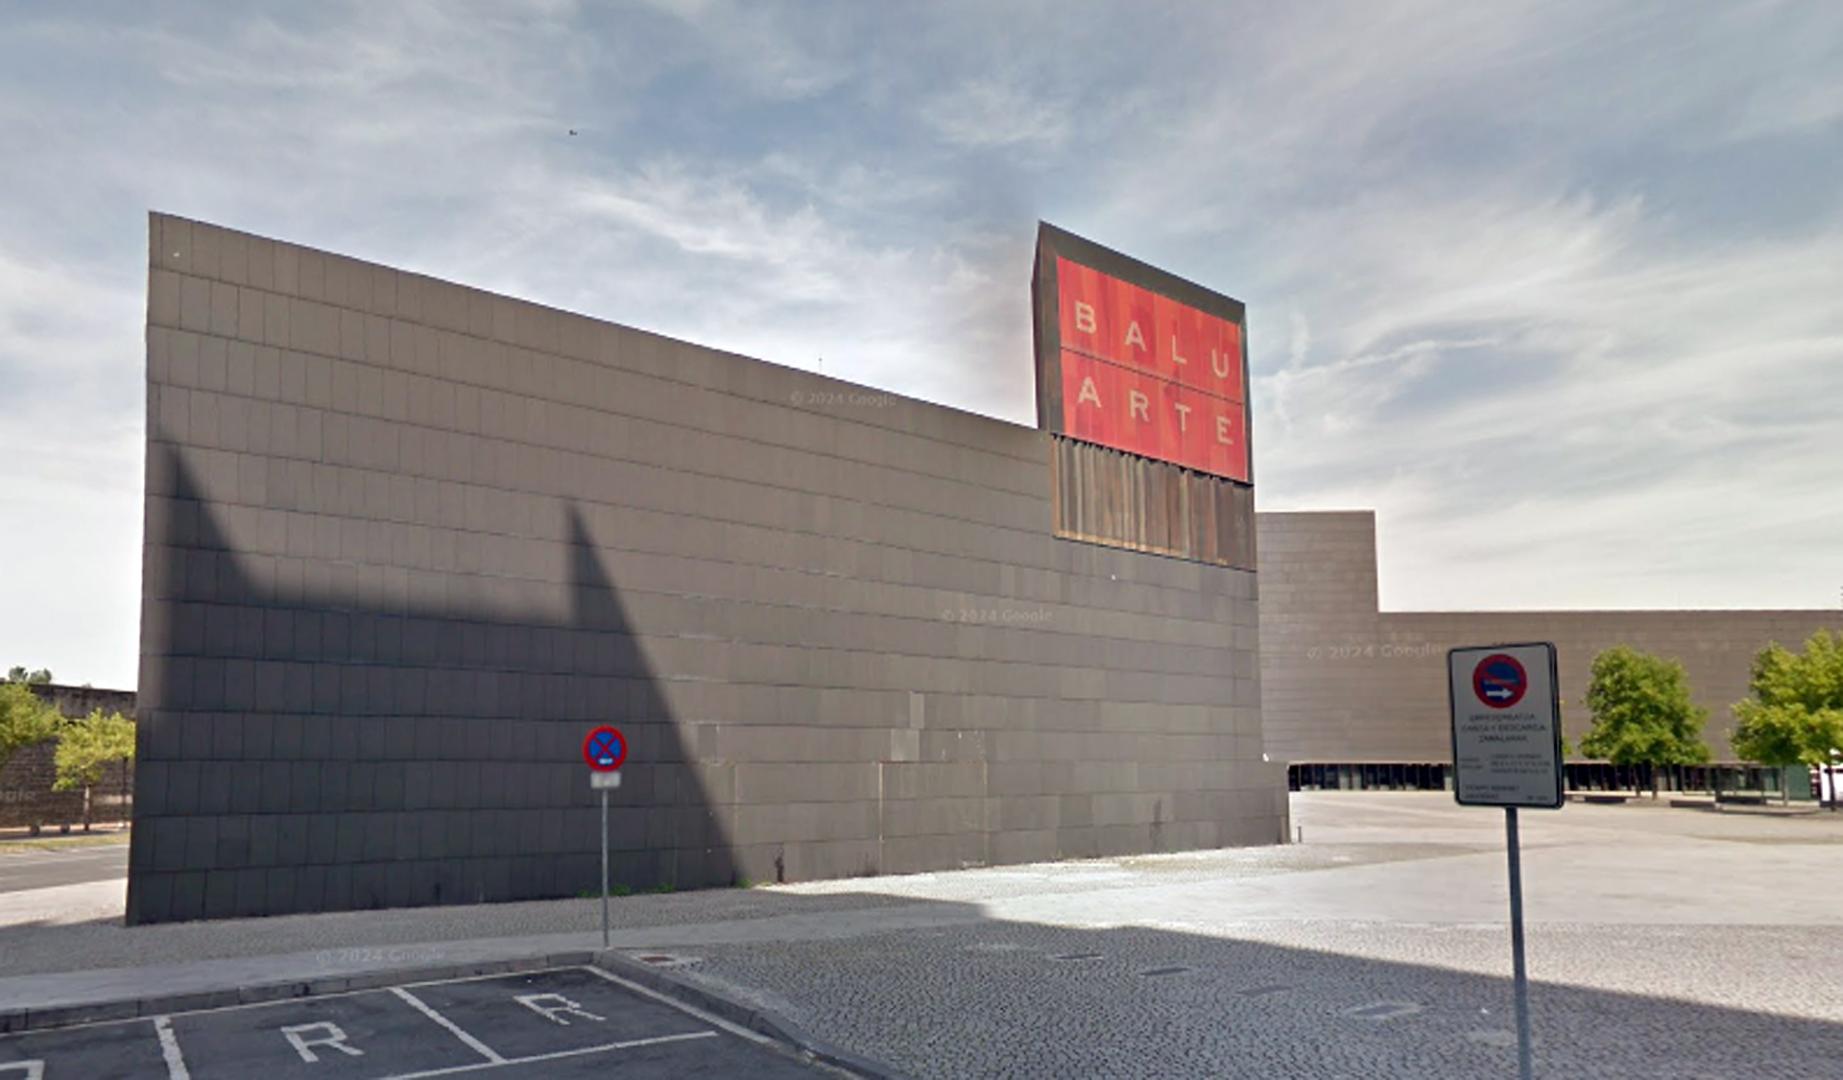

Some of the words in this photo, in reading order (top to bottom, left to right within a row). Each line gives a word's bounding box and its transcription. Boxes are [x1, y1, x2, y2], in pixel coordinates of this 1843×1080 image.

[1074, 301, 1230, 379] BALU
[1078, 376, 1233, 445] ARTE
[513, 993, 606, 1025] R
[281, 1021, 365, 1062] R
